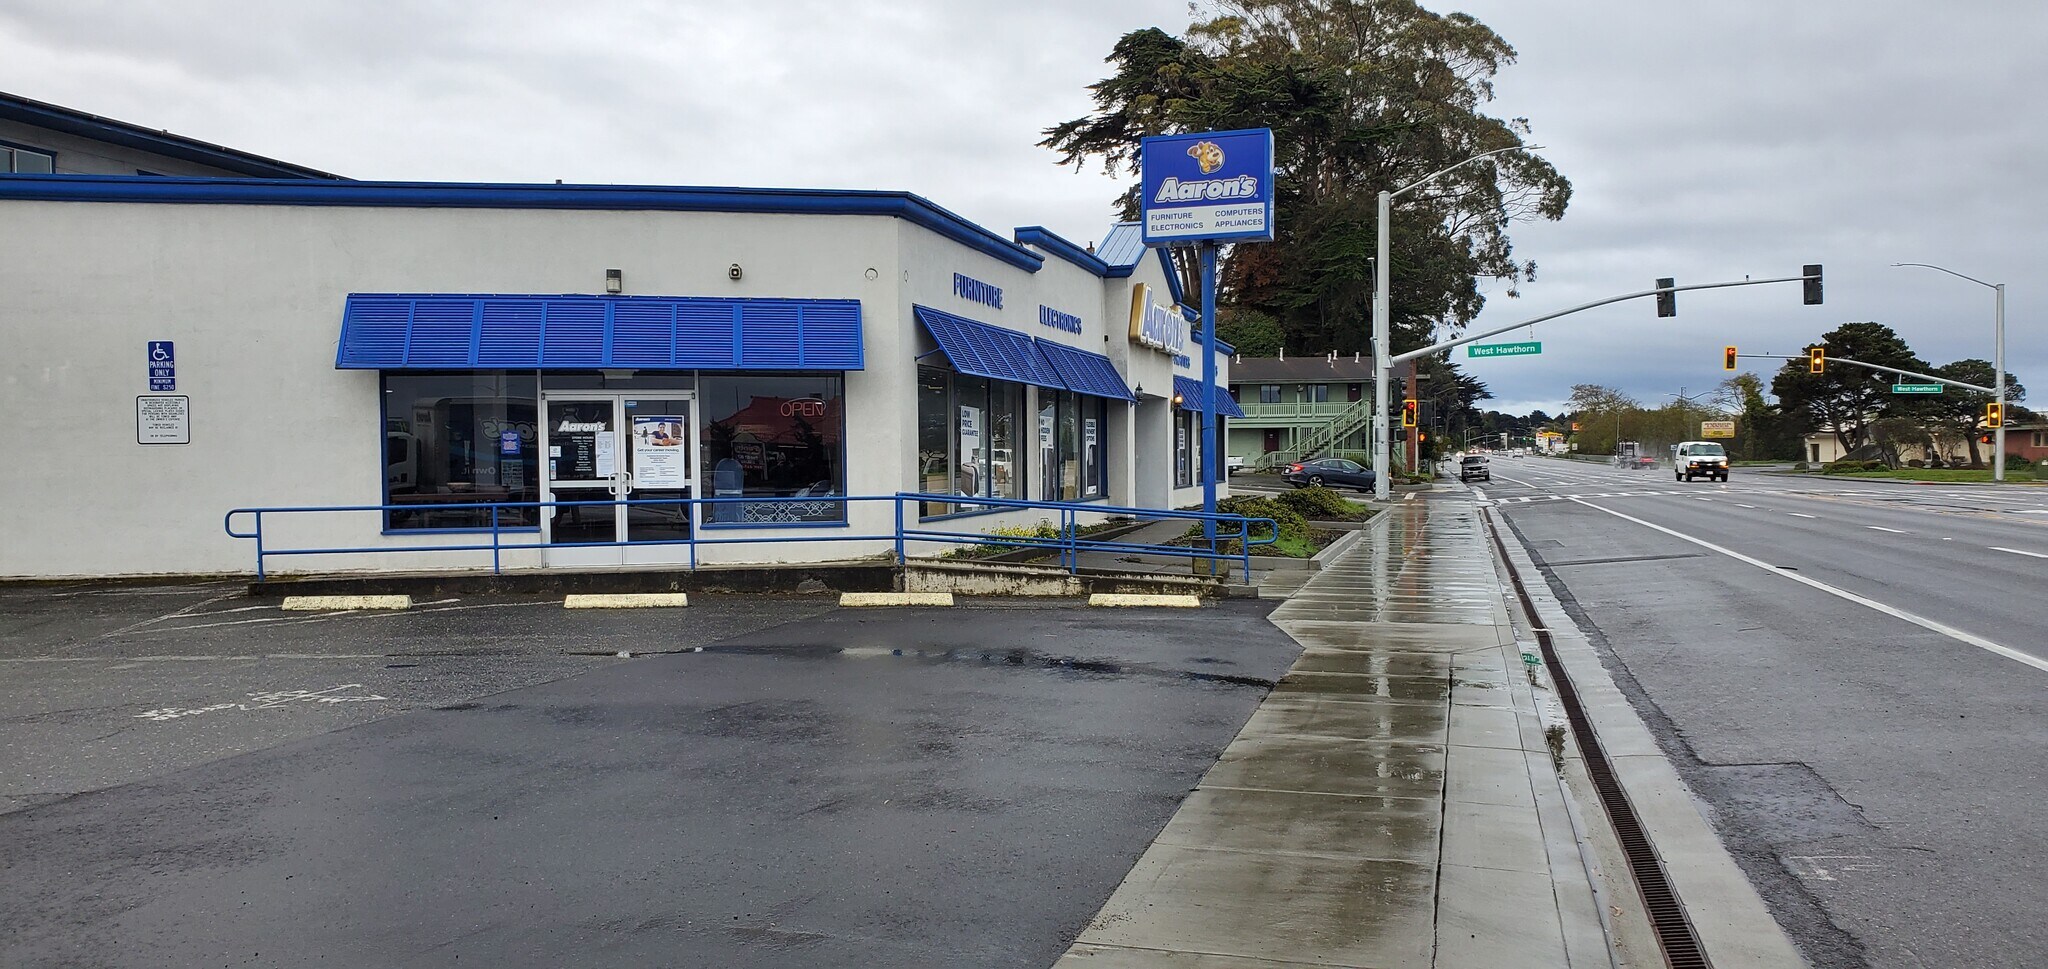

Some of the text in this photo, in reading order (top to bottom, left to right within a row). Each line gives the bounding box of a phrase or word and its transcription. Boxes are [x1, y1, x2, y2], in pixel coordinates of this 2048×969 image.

[1154, 175, 1257, 203] Aaron's
[1151, 212, 1193, 221] FURNITURE
[1215, 207, 1263, 217] COMPUTERS
[1151, 222, 1204, 231] ELECTRONICS
[1214, 218, 1263, 228] APPLIANCES
[953, 272, 1004, 310] FURNITURE
[1039, 304, 1083, 335] ELECTRONICS
[1140, 285, 1184, 355] Aaron's
[1474, 346, 1535, 355] West Hawthorn
[780, 401, 824, 417] OPEN
[962, 410, 971, 418] LOW
[558, 420, 606, 432] Aaron's
[962, 419, 972, 428] PRICE
[962, 429, 979, 437] GUARANTEE
